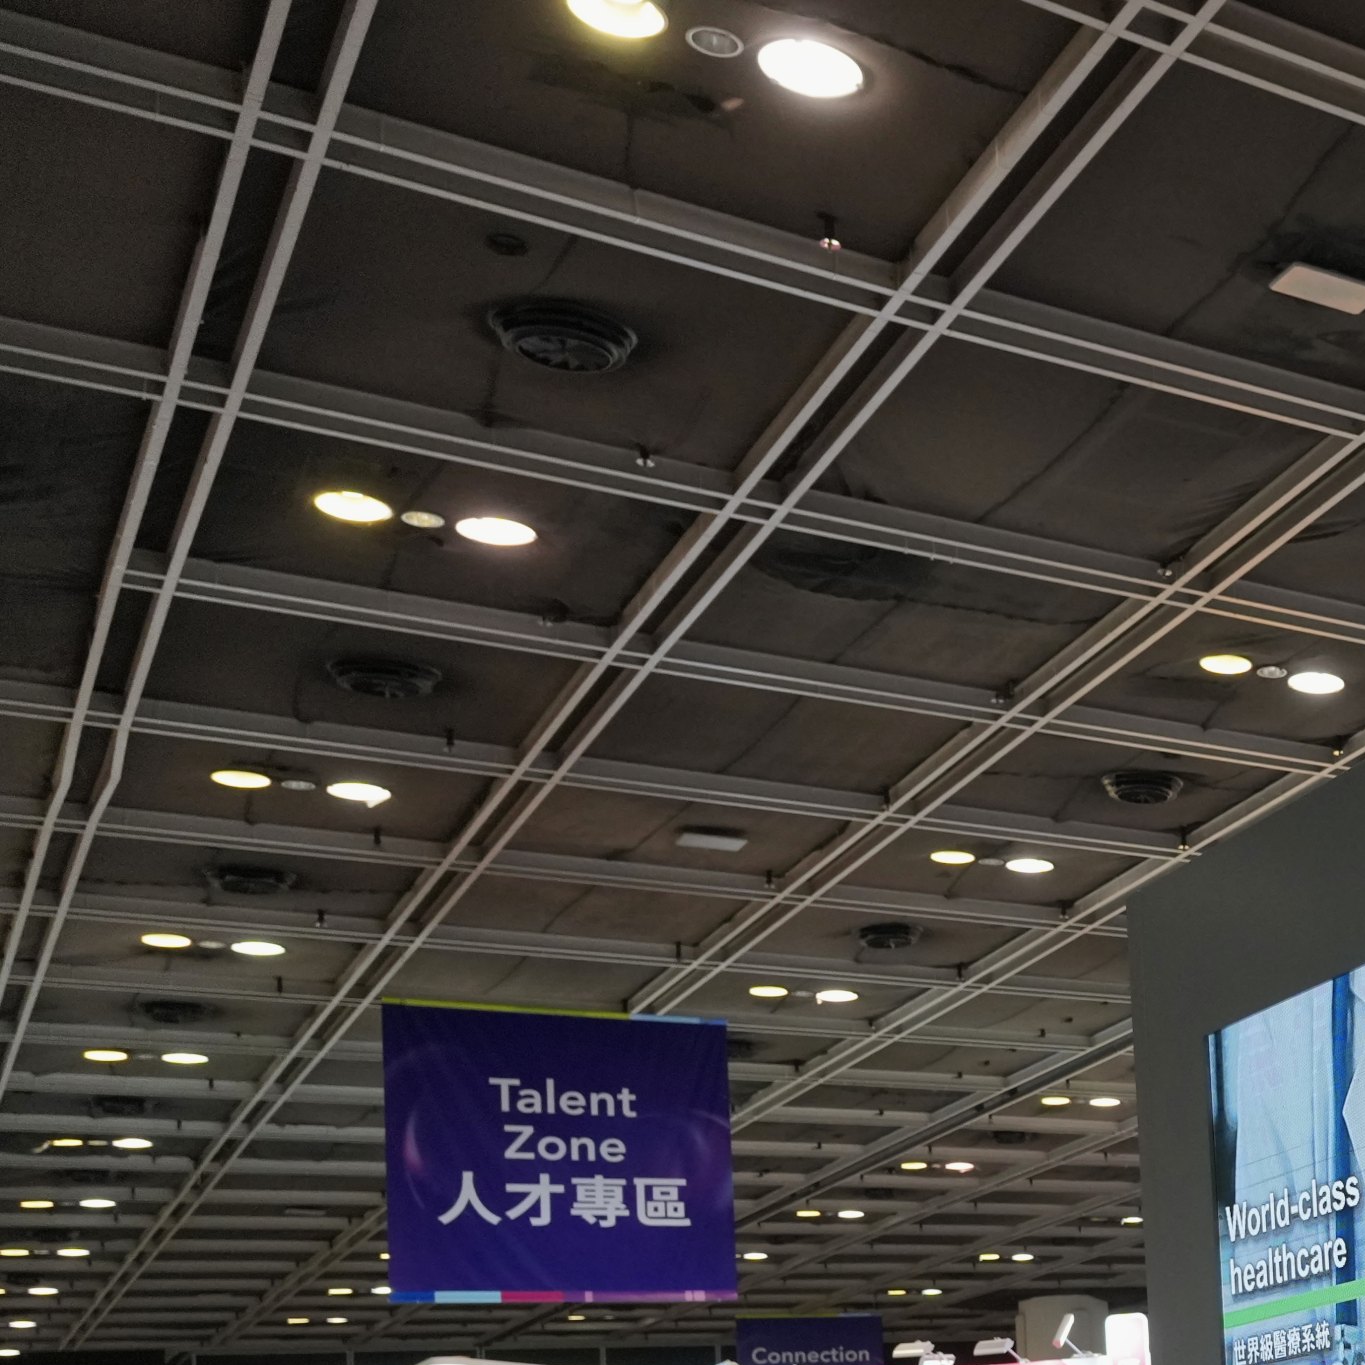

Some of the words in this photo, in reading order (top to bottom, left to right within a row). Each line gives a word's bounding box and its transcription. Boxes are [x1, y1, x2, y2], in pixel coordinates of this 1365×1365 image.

[488, 1077, 638, 1118] Talent
[504, 1124, 627, 1163] Zone
[437, 1170, 692, 1228] 人才專區
[1225, 1175, 1360, 1242] World-class
[1229, 1236, 1347, 1295] healthcare
[751, 1346, 870, 1365] Connection
